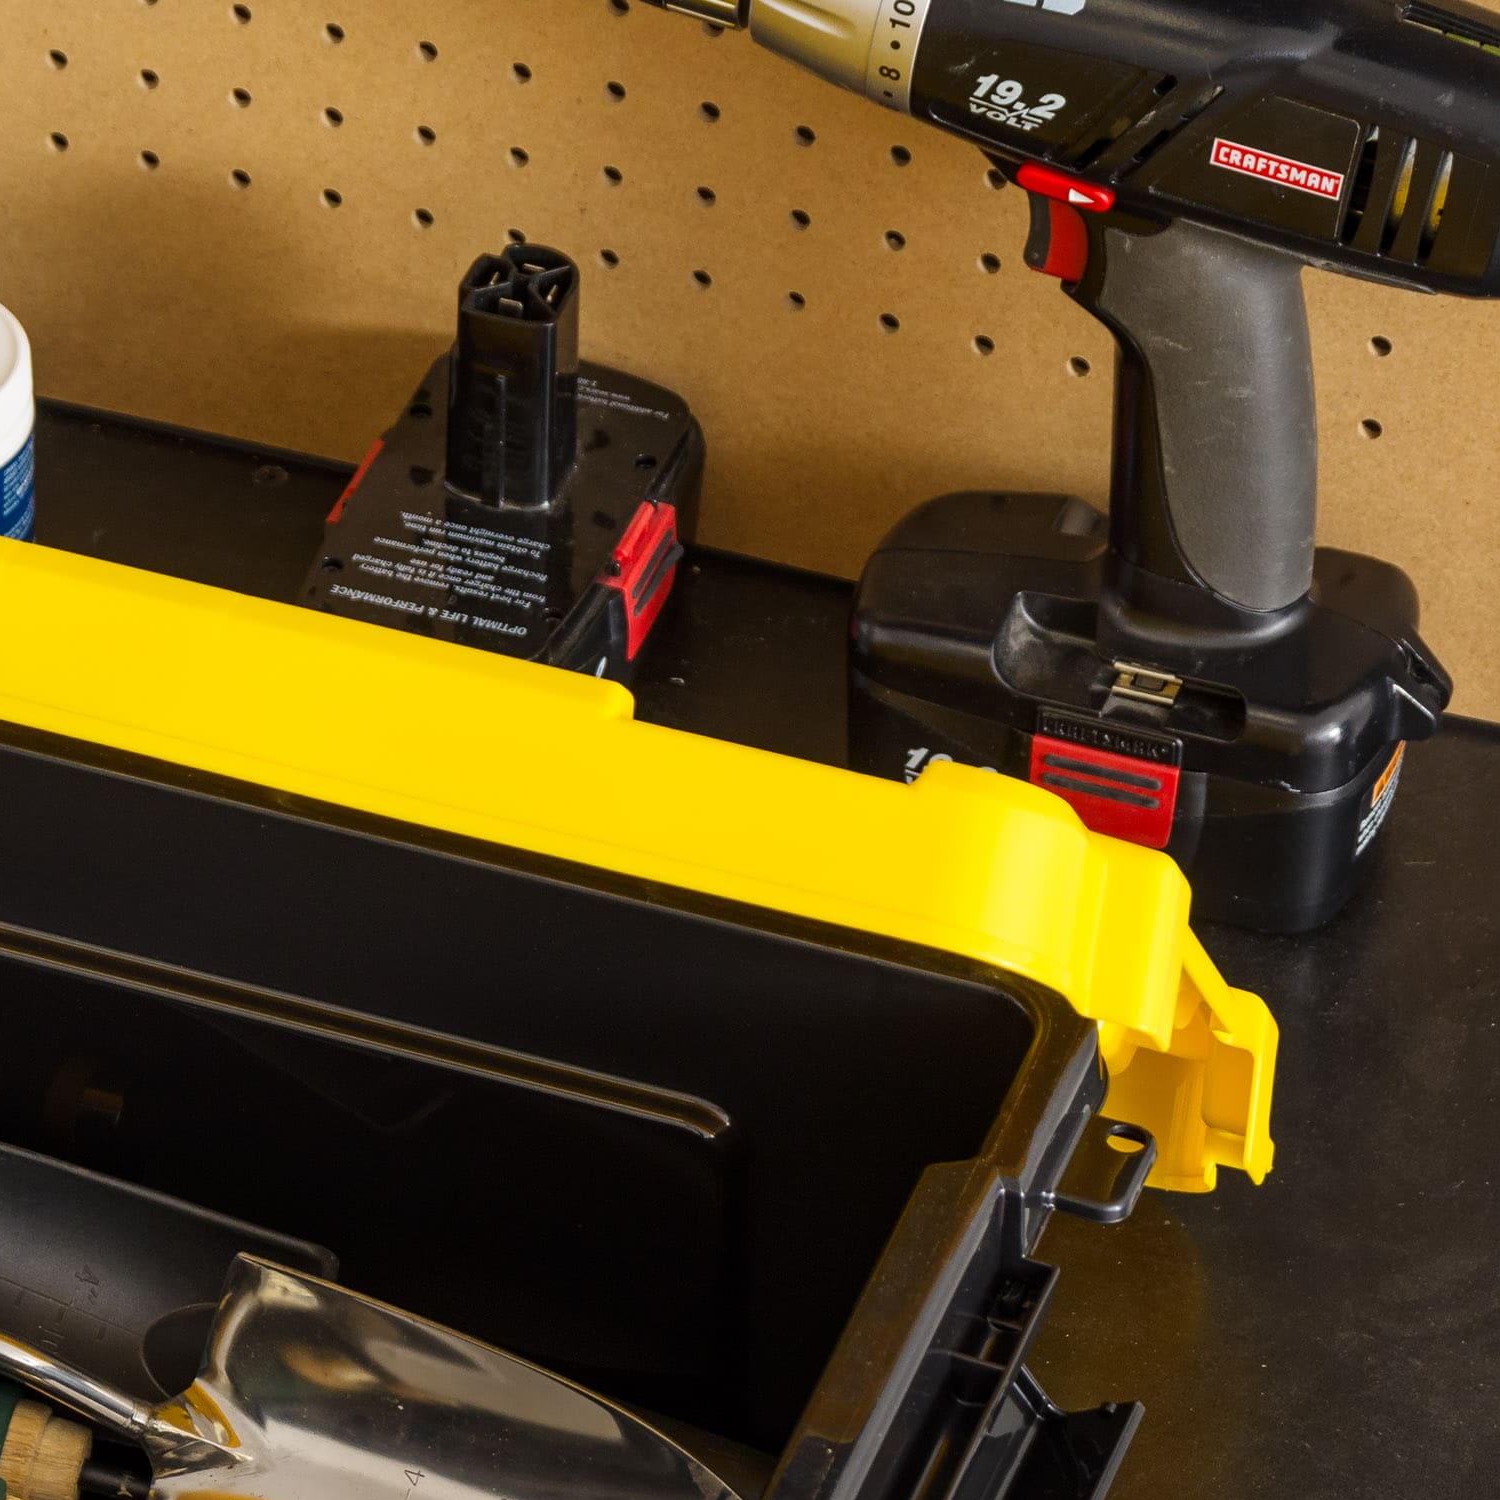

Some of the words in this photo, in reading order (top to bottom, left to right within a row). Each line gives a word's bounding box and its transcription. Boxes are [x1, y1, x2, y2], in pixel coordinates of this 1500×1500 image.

[889, 0, 915, 29] 10
[879, 65, 900, 81] 8
[973, 73, 1067, 120] 19.2
[968, 103, 1041, 131] VOLT
[1218, 146, 1335, 193] CRAFTSMAN
[427, 526, 446, 535] run
[442, 520, 467, 531] once
[447, 530, 495, 545] maximum
[468, 526, 515, 542] overnight
[371, 535, 436, 555] performance
[495, 541, 528, 553] obtain
[515, 536, 551, 549] charge
[350, 552, 393, 567] charged
[408, 557, 428, 566] use
[436, 550, 463, 561] when
[463, 555, 499, 569] battery
[472, 549, 506, 562] begins
[357, 562, 394, 576] battery
[394, 561, 416, 572] fully
[428, 562, 444, 570] for
[445, 564, 474, 576] ready
[500, 563, 548, 580] Recharge
[394, 571, 411, 579] the
[412, 575, 450, 588] remove
[437, 572, 462, 582] once
[474, 572, 494, 581] and
[462, 577, 503, 592] charger
[503, 587, 521, 595] the
[328, 583, 425, 612] PERFORMANCE
[489, 592, 512, 602] best
[513, 597, 531, 607] For
[522, 591, 547, 601] from
[426, 606, 438, 616] &
[439, 609, 469, 623] LIFE
[469, 616, 528, 636] OPTIMAL
[404, 1469, 426, 1486] 4
